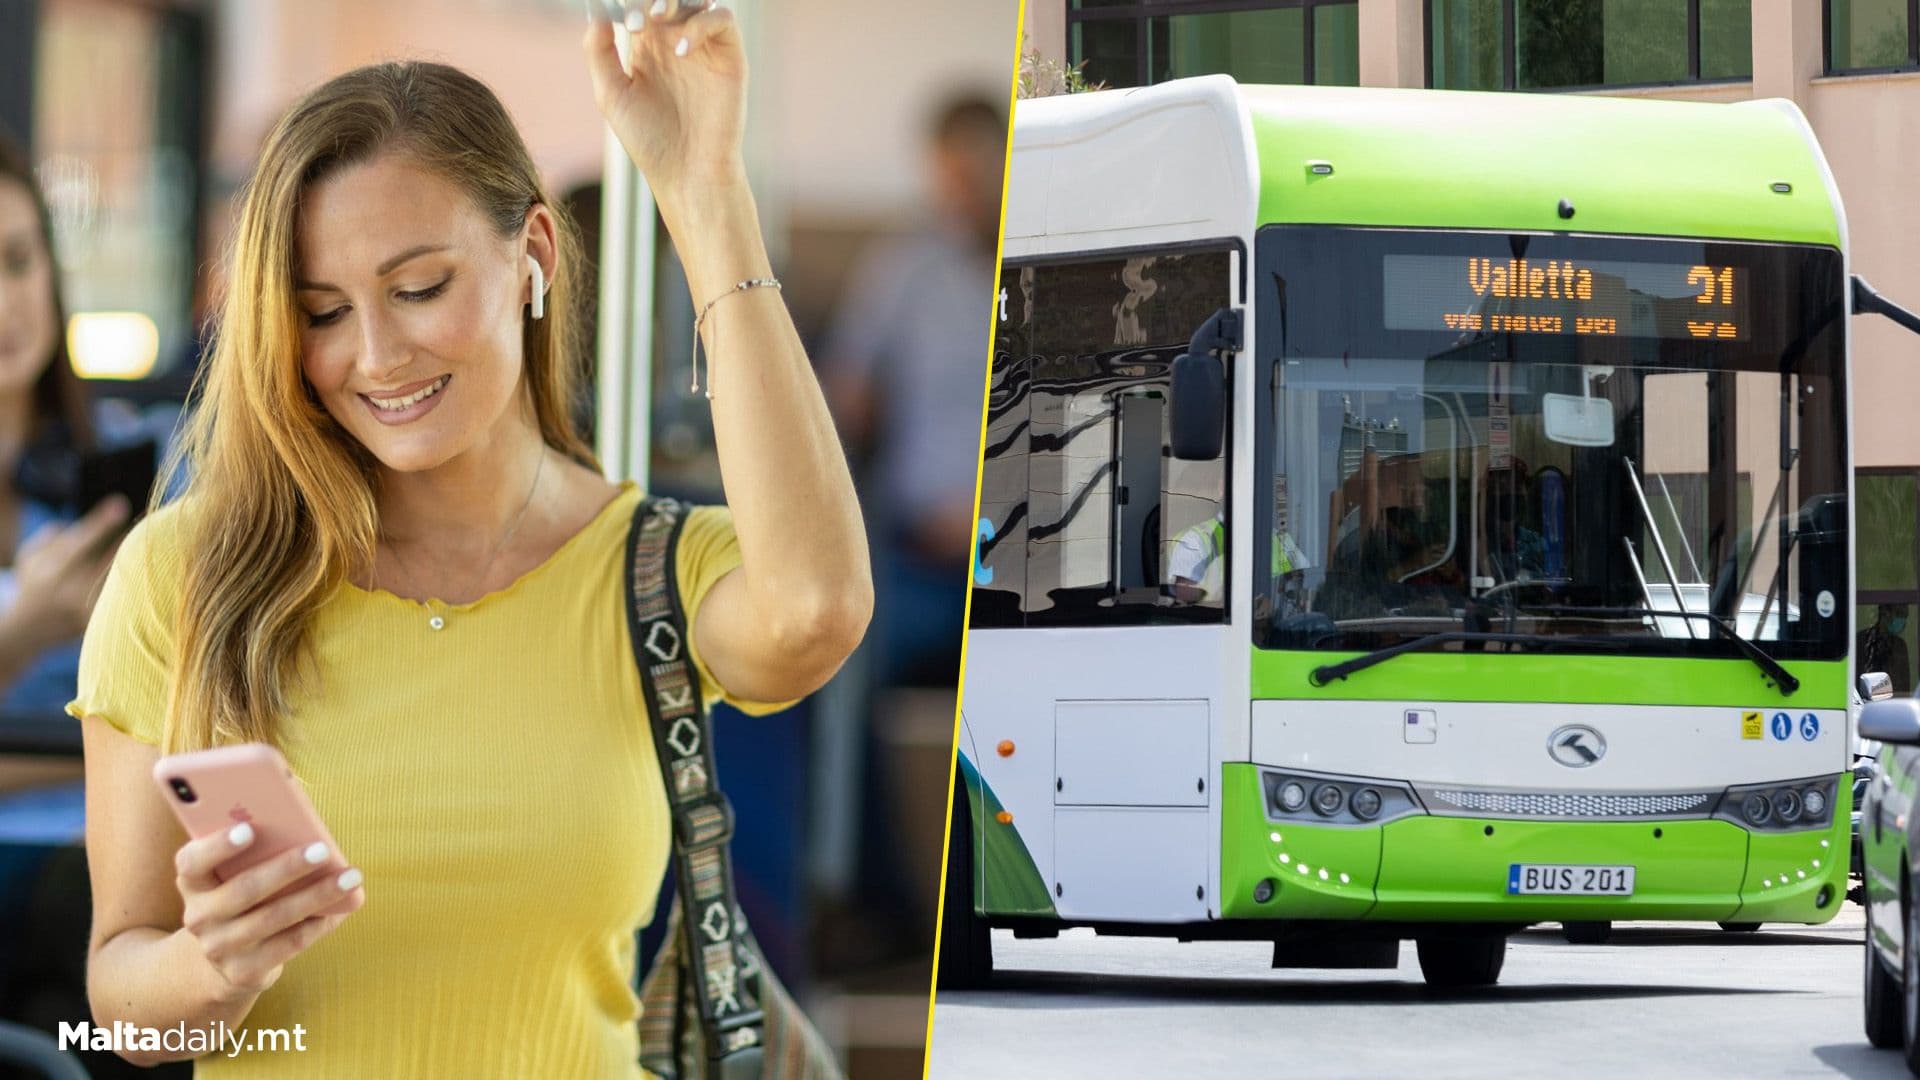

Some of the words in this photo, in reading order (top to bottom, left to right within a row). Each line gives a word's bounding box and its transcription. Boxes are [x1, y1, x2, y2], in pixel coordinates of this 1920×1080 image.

[1468, 257, 1593, 300] Valletta
[1525, 867, 1574, 891] BUS
[1583, 868, 1627, 892] 201
